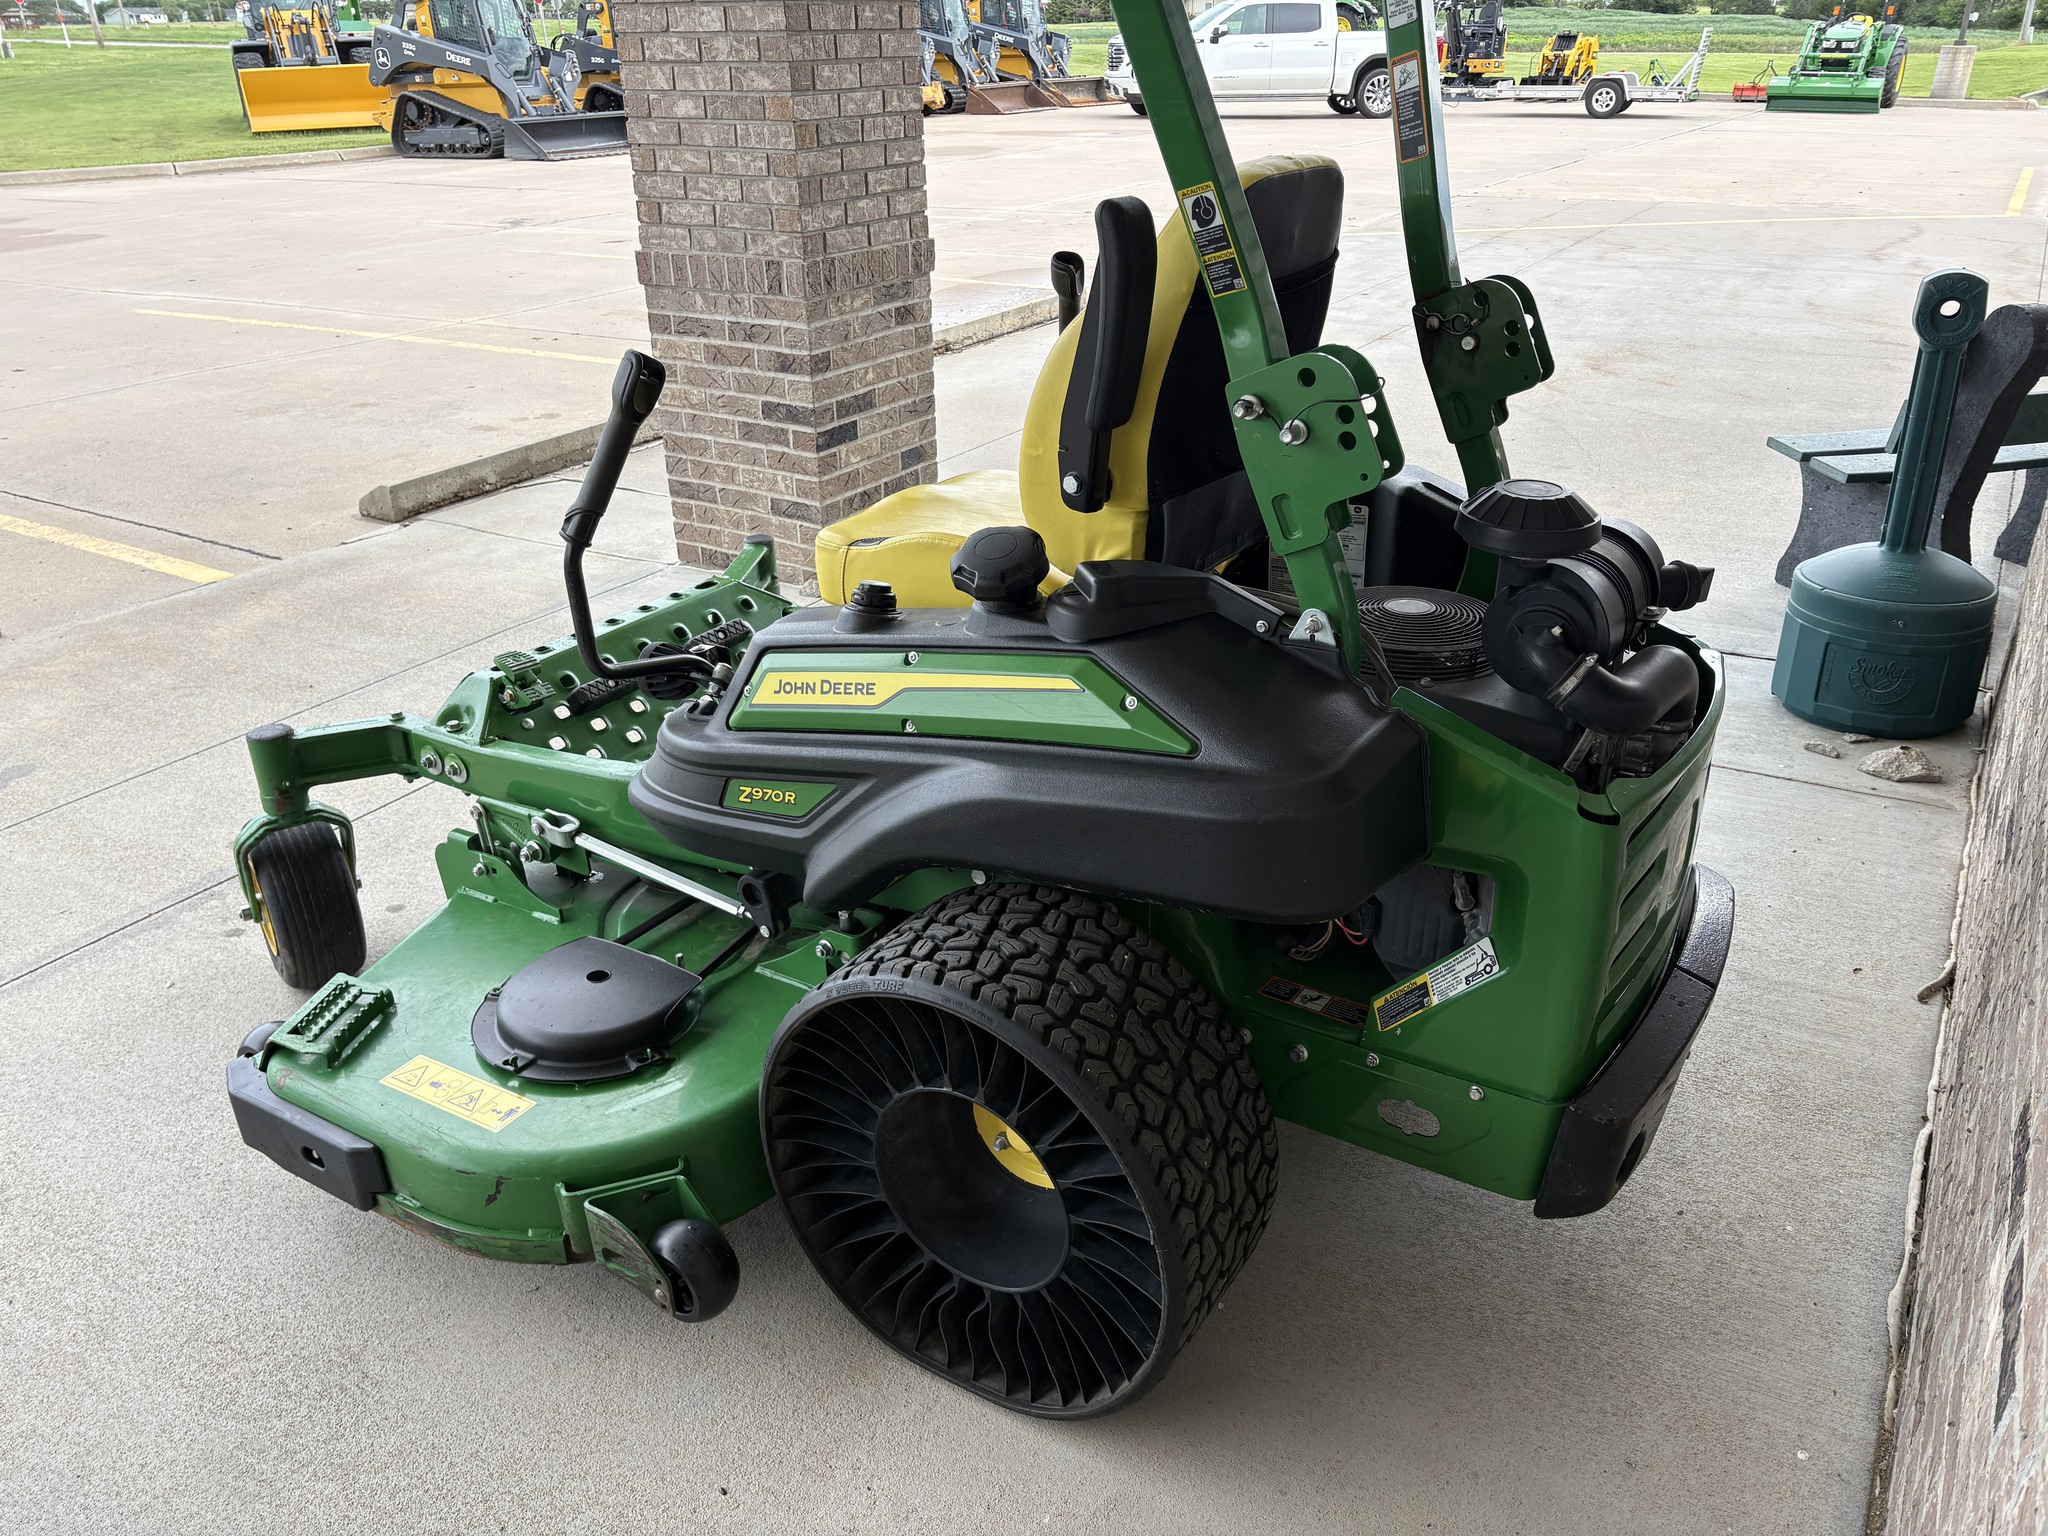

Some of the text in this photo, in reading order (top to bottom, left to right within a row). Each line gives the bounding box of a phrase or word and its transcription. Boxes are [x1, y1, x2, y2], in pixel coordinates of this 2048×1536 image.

[994, 32, 1015, 43] DEERE
[445, 50, 472, 66] DEERE
[1186, 184, 1211, 196] CAUTION
[1207, 251, 1235, 263] ATENCIÓN
[1850, 656, 1915, 681] Smokers
[773, 679, 876, 695] JOHN DEERE
[738, 784, 797, 805] Z970R
[873, 980, 905, 992] TURF
[1389, 980, 1418, 1000] ATENCIÓN
